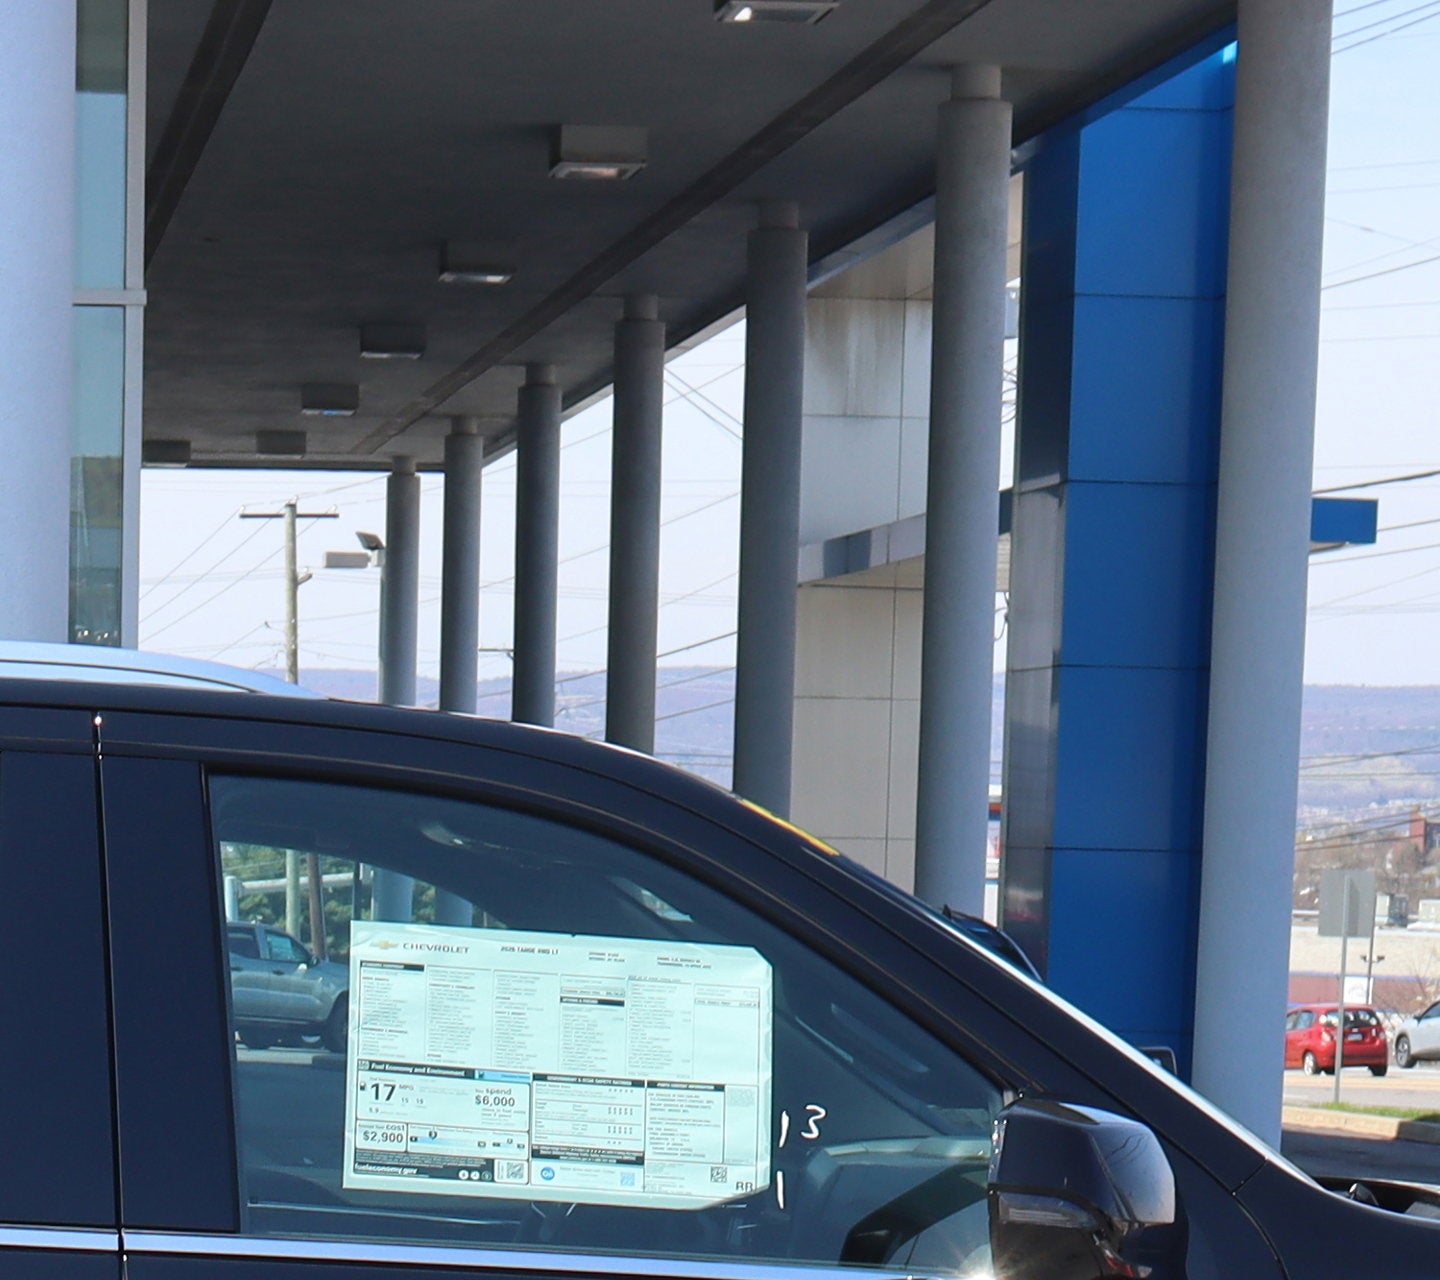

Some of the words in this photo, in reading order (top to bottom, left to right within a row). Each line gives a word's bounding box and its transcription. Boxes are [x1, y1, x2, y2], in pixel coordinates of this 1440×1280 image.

[403, 942, 470, 954] CHEVROLET
[371, 1083, 396, 1101] 17
[485, 1088, 512, 1096] spend
[475, 1094, 516, 1107] $6,000
[363, 1130, 403, 1144] $2,900
[735, 1181, 754, 1192] RR
